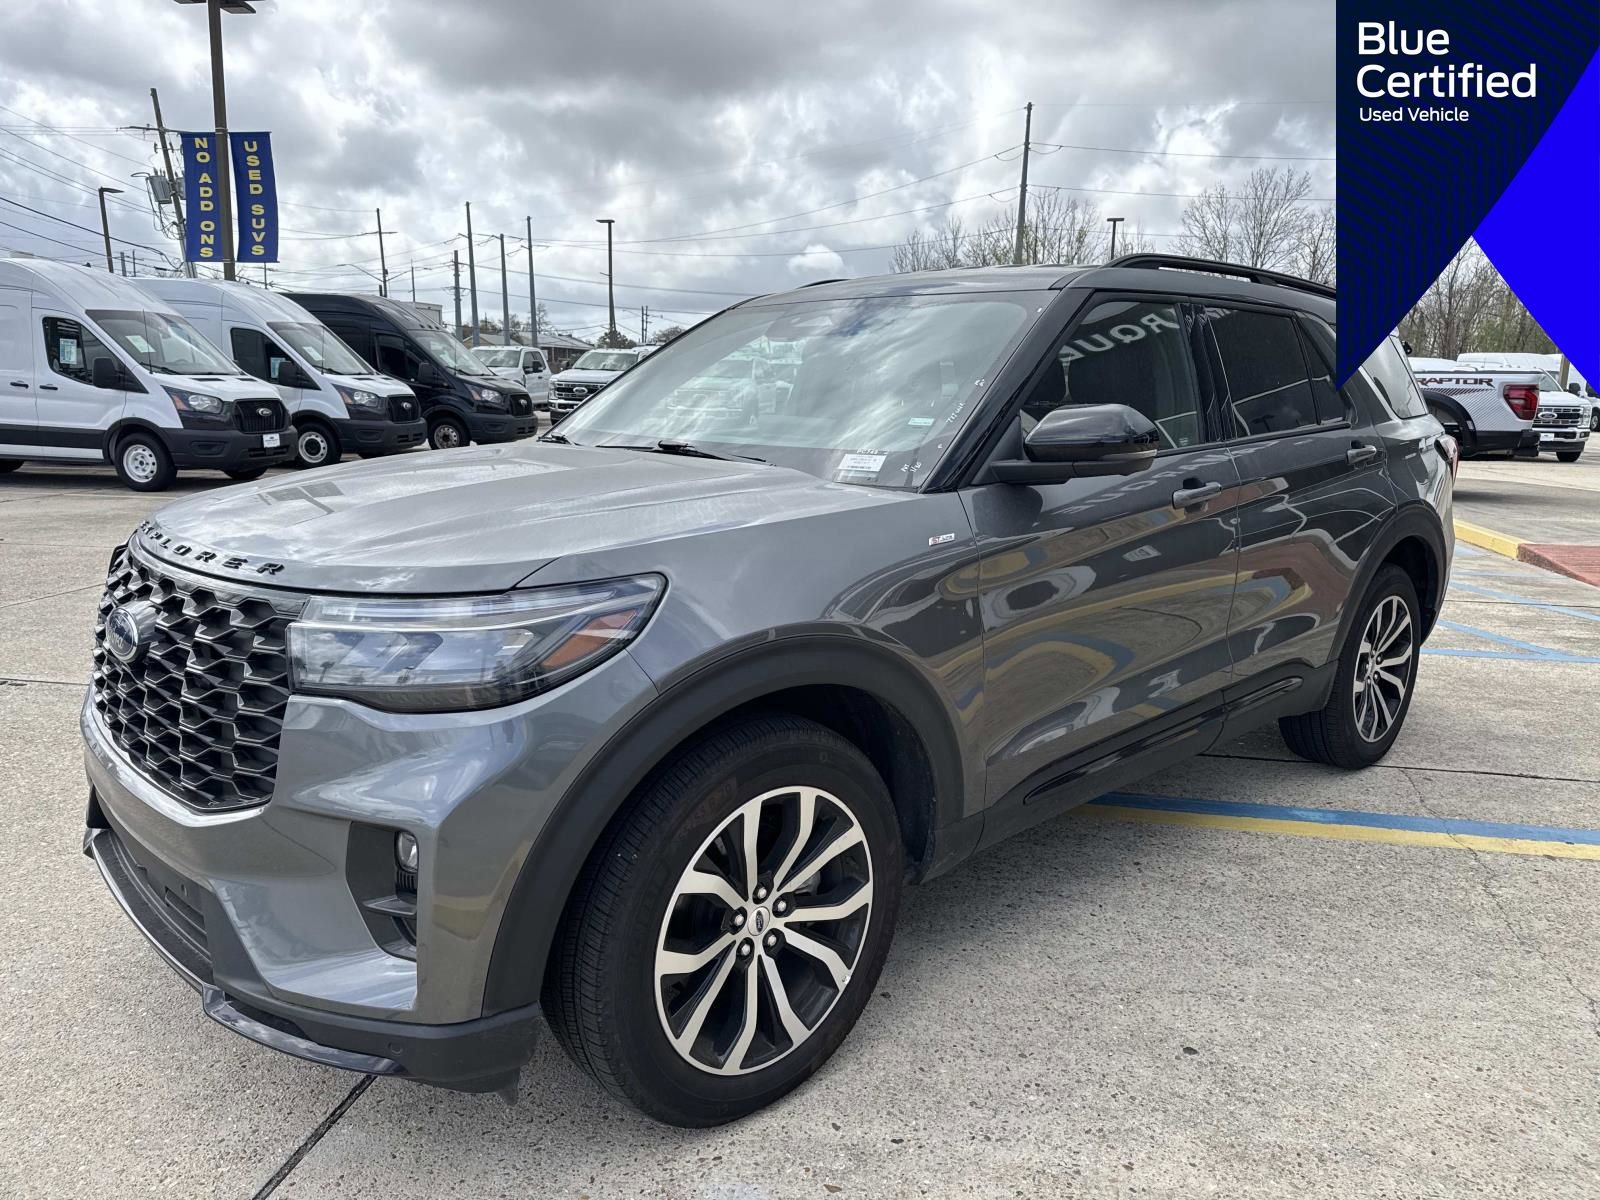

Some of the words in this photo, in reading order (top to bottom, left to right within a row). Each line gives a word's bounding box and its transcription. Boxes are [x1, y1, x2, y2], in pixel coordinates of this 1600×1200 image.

[194, 137, 210, 163] NO
[244, 140, 263, 194] USED
[199, 172, 213, 211] ADD
[200, 220, 215, 258] ONS
[251, 204, 266, 256] SUVS
[1416, 378, 1495, 388] RAPTOR
[140, 520, 285, 576] EXPLORER
